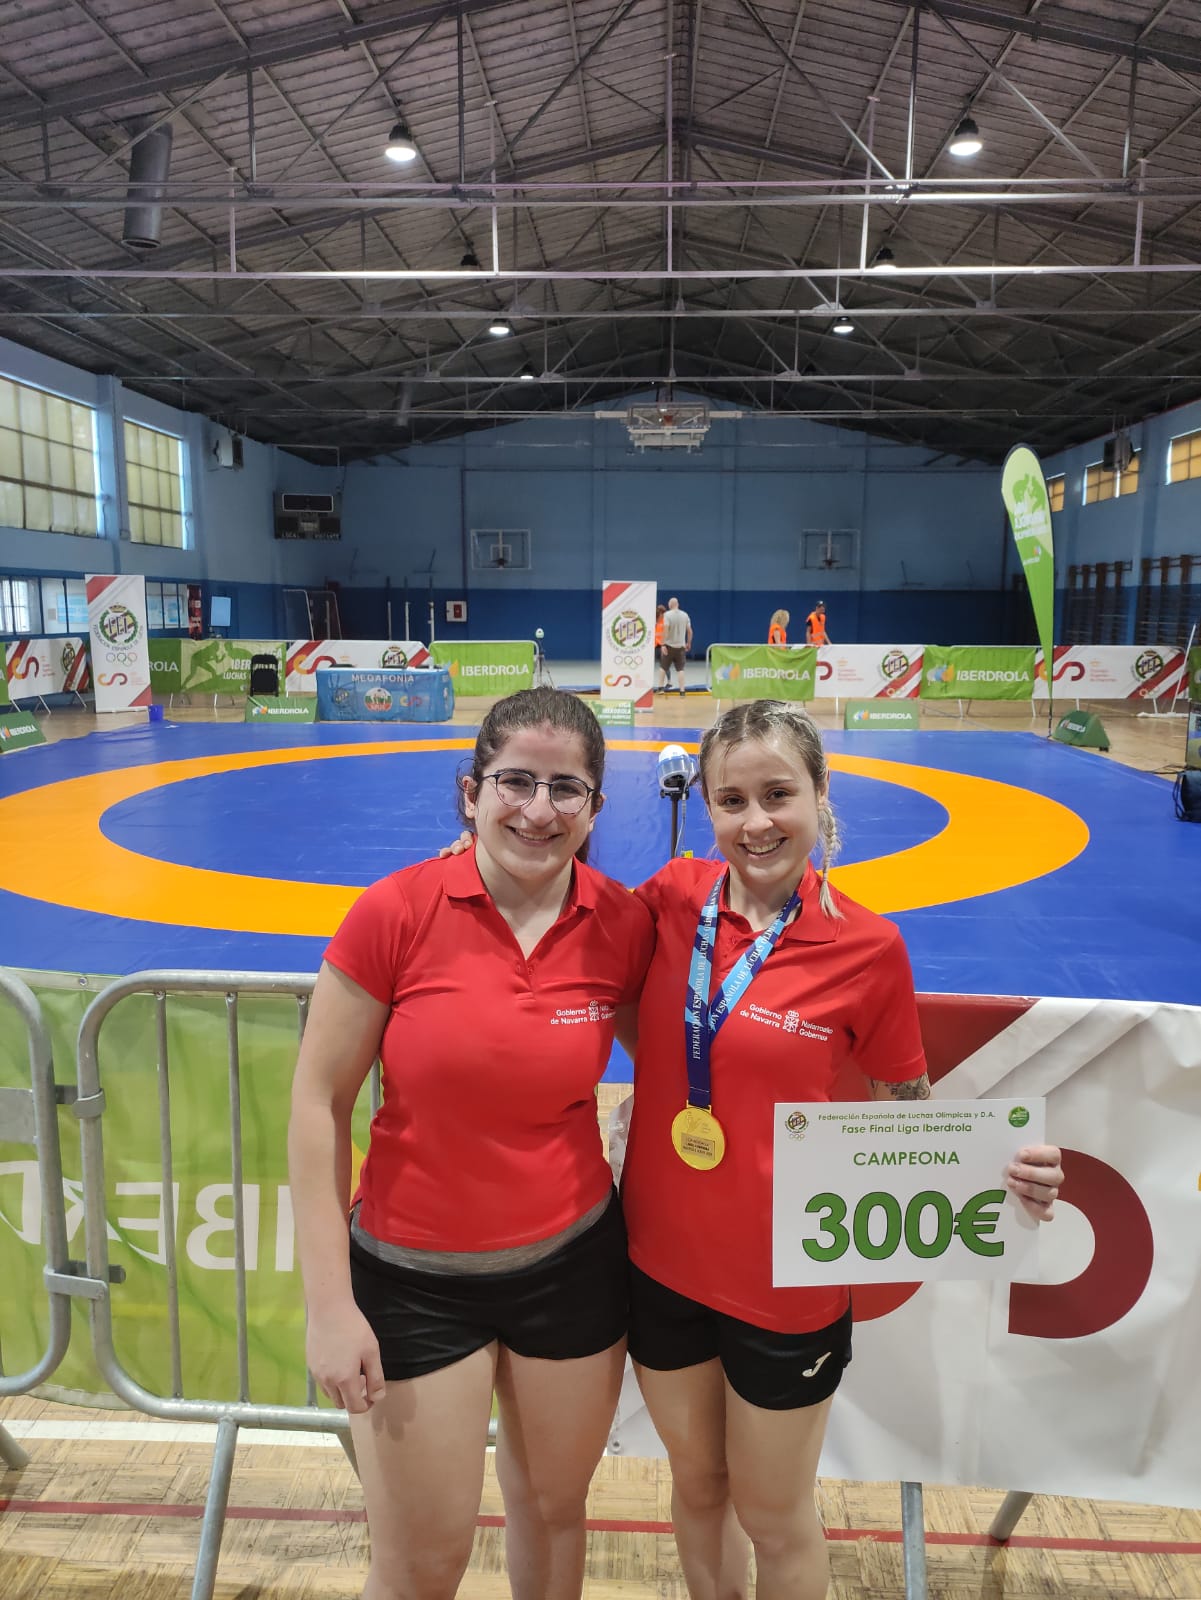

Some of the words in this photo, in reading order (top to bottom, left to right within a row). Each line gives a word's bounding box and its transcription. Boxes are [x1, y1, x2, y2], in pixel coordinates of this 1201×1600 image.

[461, 664, 529, 677] IBERDROLA
[743, 667, 811, 681] IBERDROLA
[956, 670, 1030, 682] IBERDROLA
[556, 1008, 587, 1017] Gobierno
[749, 1003, 783, 1020] Gobierno
[550, 1017, 560, 1025] de
[560, 1016, 588, 1025] Navarra
[739, 1009, 750, 1018] de
[750, 1012, 780, 1028] Navarra
[980, 1110, 996, 1118] D.A.
[842, 1124, 866, 1134] Fase
[869, 1123, 894, 1133] Final
[897, 1123, 920, 1135] Liga
[922, 1122, 973, 1133] Iberdrola
[853, 1150, 960, 1166] CAMPEONA
[802, 1189, 1007, 1262] 300€
